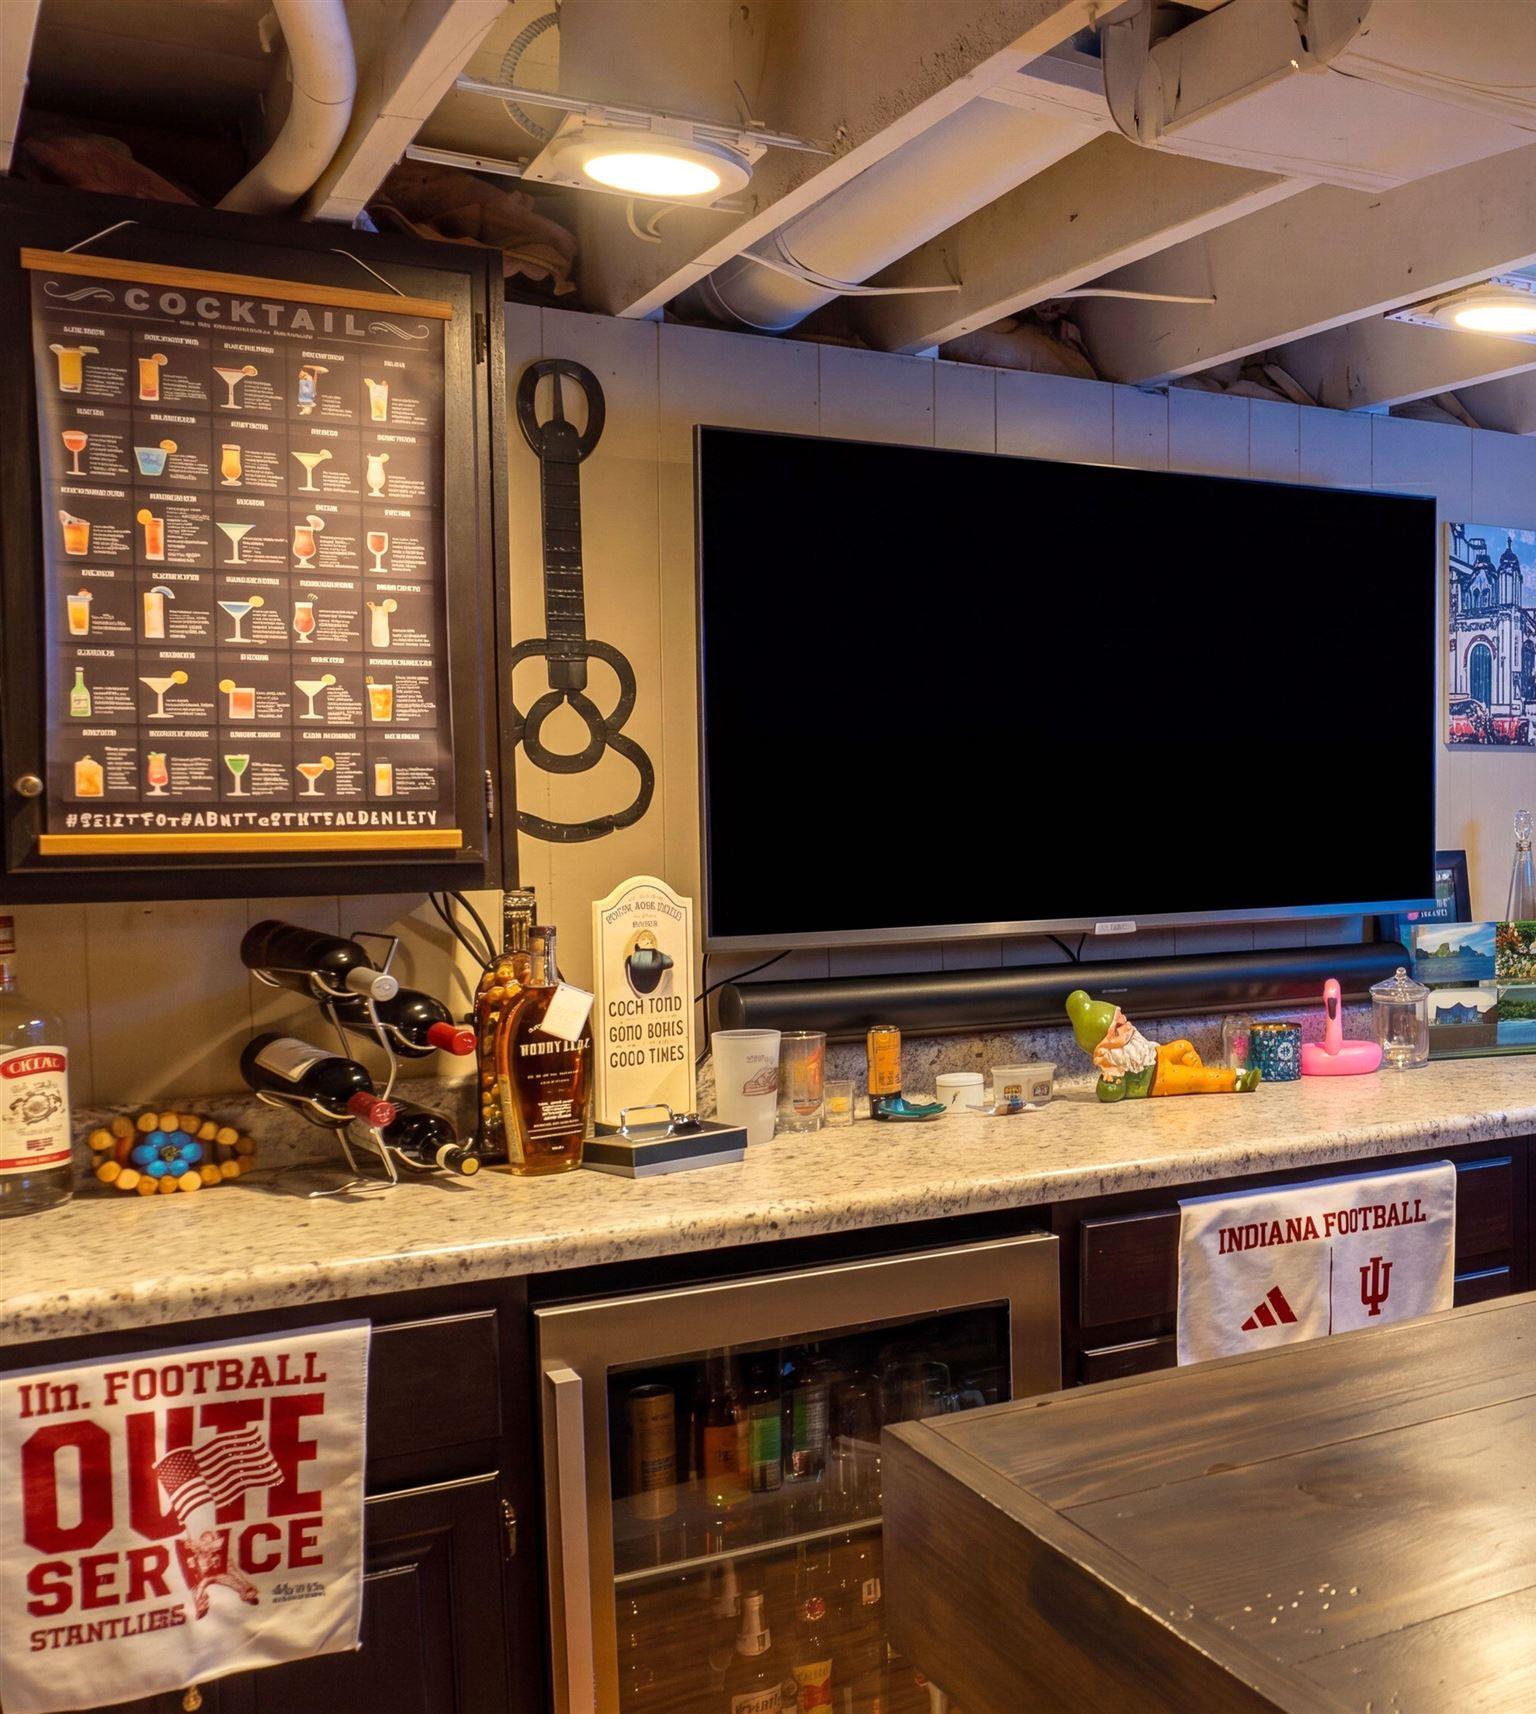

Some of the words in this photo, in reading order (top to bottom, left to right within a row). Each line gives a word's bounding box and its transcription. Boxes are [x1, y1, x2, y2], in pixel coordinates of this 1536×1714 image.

[124, 288, 367, 337] COCKTAIL
[1218, 1216, 1320, 1255] INDIANA
[1323, 1199, 1427, 1239] FOOTBALL
[103, 1352, 326, 1407] FOOTBALL
